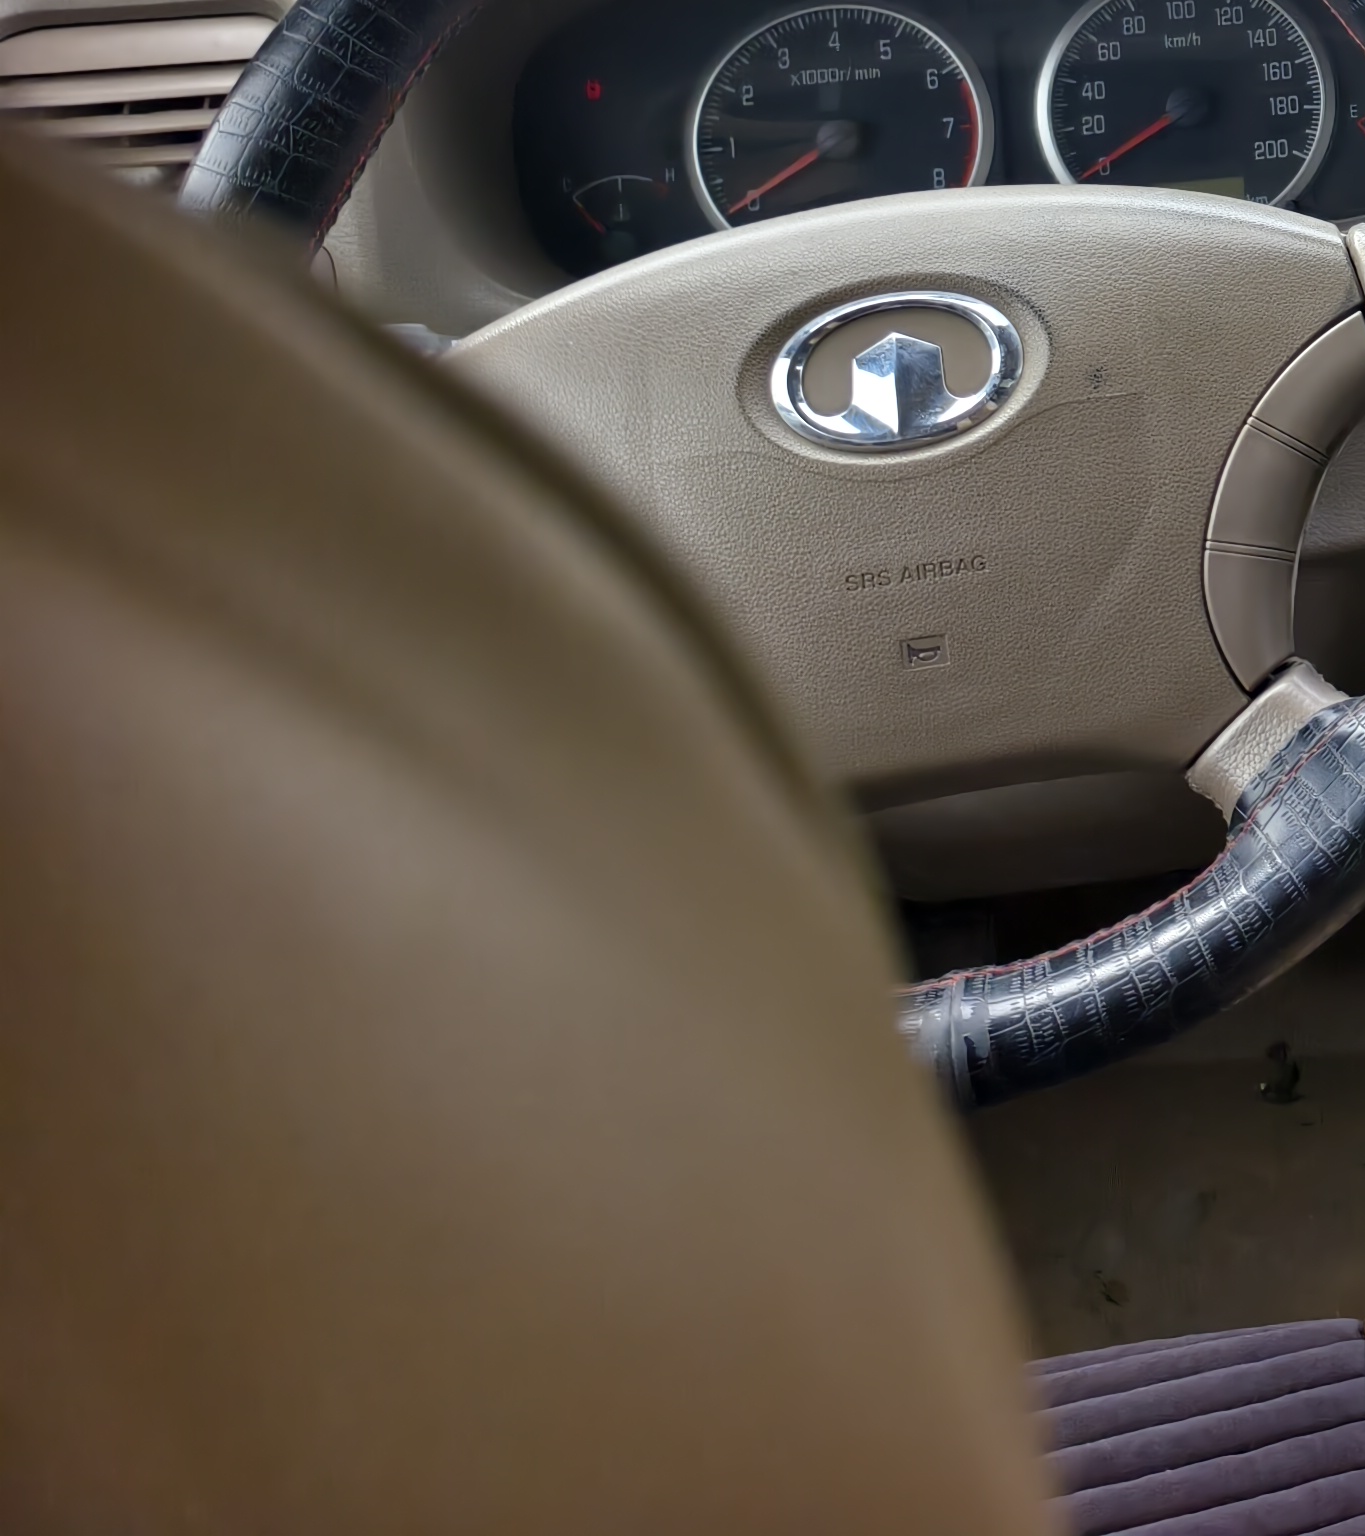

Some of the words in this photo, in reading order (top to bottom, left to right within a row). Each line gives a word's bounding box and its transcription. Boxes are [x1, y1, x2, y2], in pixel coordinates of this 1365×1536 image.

[1166, 0, 1196, 21] 100
[1215, 5, 1244, 27] 120
[1123, 15, 1146, 37] 80
[828, 31, 841, 51] 4
[1164, 32, 1201, 49] km/h
[1248, 27, 1278, 49] 140
[777, 47, 791, 69] 3
[878, 39, 893, 61] 5
[1098, 40, 1121, 62] 60
[926, 70, 939, 90] 6
[1263, 60, 1293, 82] 160
[741, 84, 755, 107] 2
[1081, 80, 1106, 101] 40
[1269, 95, 1299, 116] 180
[1349, 104, 1358, 119] E
[941, 117, 955, 139] 7
[1081, 114, 1105, 136] 20
[728, 136, 736, 159] 1
[1254, 139, 1289, 161] 200
[665, 168, 675, 183] H
[1099, 156, 1111, 176] 0
[932, 168, 946, 190] 8
[747, 190, 760, 211] 0
[845, 569, 892, 592] SRS
[899, 554, 987, 584] AIRBAG
